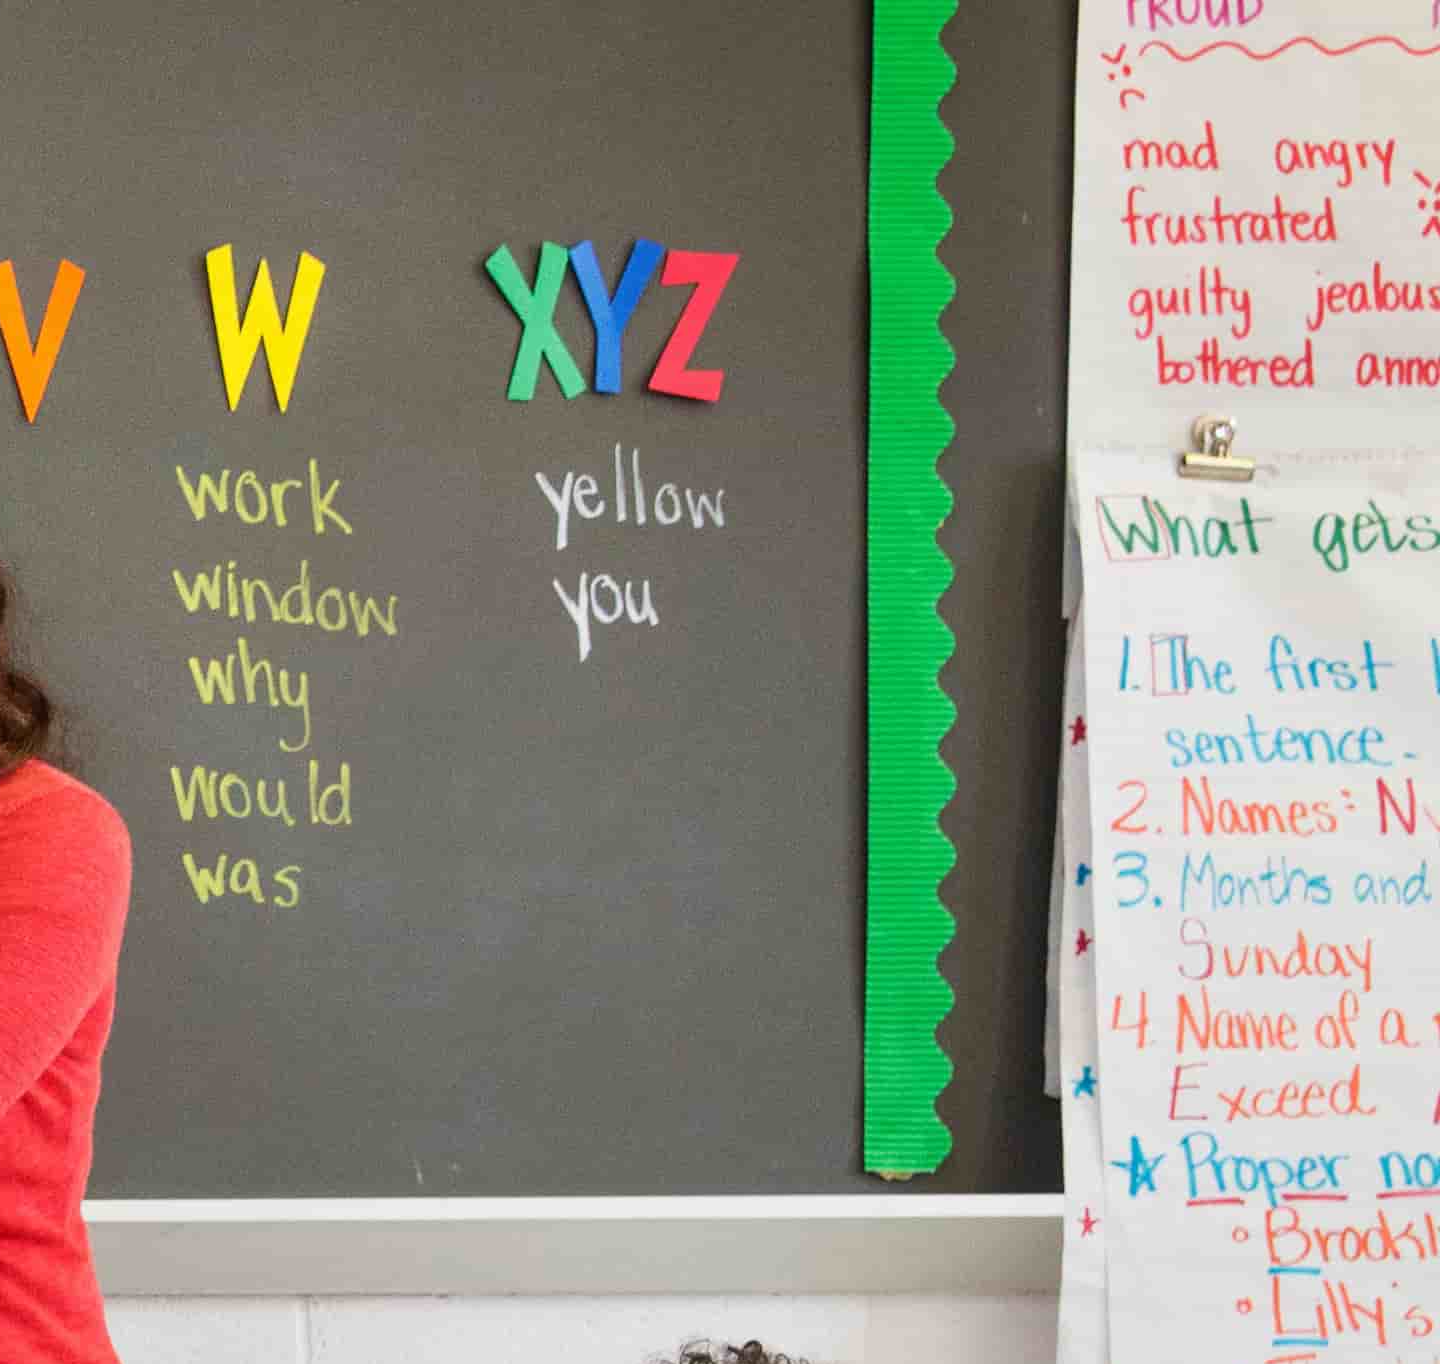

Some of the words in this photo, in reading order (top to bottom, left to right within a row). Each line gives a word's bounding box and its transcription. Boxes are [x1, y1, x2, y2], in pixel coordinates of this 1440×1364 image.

[1126, 0, 1263, 31] ROUD
[1123, 121, 1219, 171] mad
[1275, 138, 1395, 188] angry
[1121, 186, 1337, 245] frustrated
[206, 242, 326, 413] W
[1128, 266, 1252, 340] guilty
[1156, 335, 1314, 388] bothered
[176, 459, 353, 534] work
[535, 442, 726, 550] yellow
[1098, 495, 1273, 558] What
[1312, 498, 1440, 572] gets
[173, 559, 397, 637] window
[553, 571, 658, 663] you
[188, 637, 310, 752] why
[1153, 634, 1237, 694] The
[1266, 633, 1394, 692] first
[171, 760, 352, 826] would
[1181, 776, 1356, 836] Names:
[1376, 777, 1440, 836] N
[183, 854, 302, 907] was
[1113, 851, 1163, 908] 3.
[1180, 850, 1333, 912] Months
[1353, 858, 1432, 906] and
[1177, 916, 1373, 992] Sunday
[1176, 984, 1297, 1053] Name
[1314, 989, 1360, 1050] of
[1379, 1008, 1421, 1048] a
[1169, 1062, 1377, 1123] Exceed
[1180, 1132, 1349, 1208] Proper
[1376, 1151, 1440, 1190] no
[1266, 1206, 1440, 1266] Brookl
